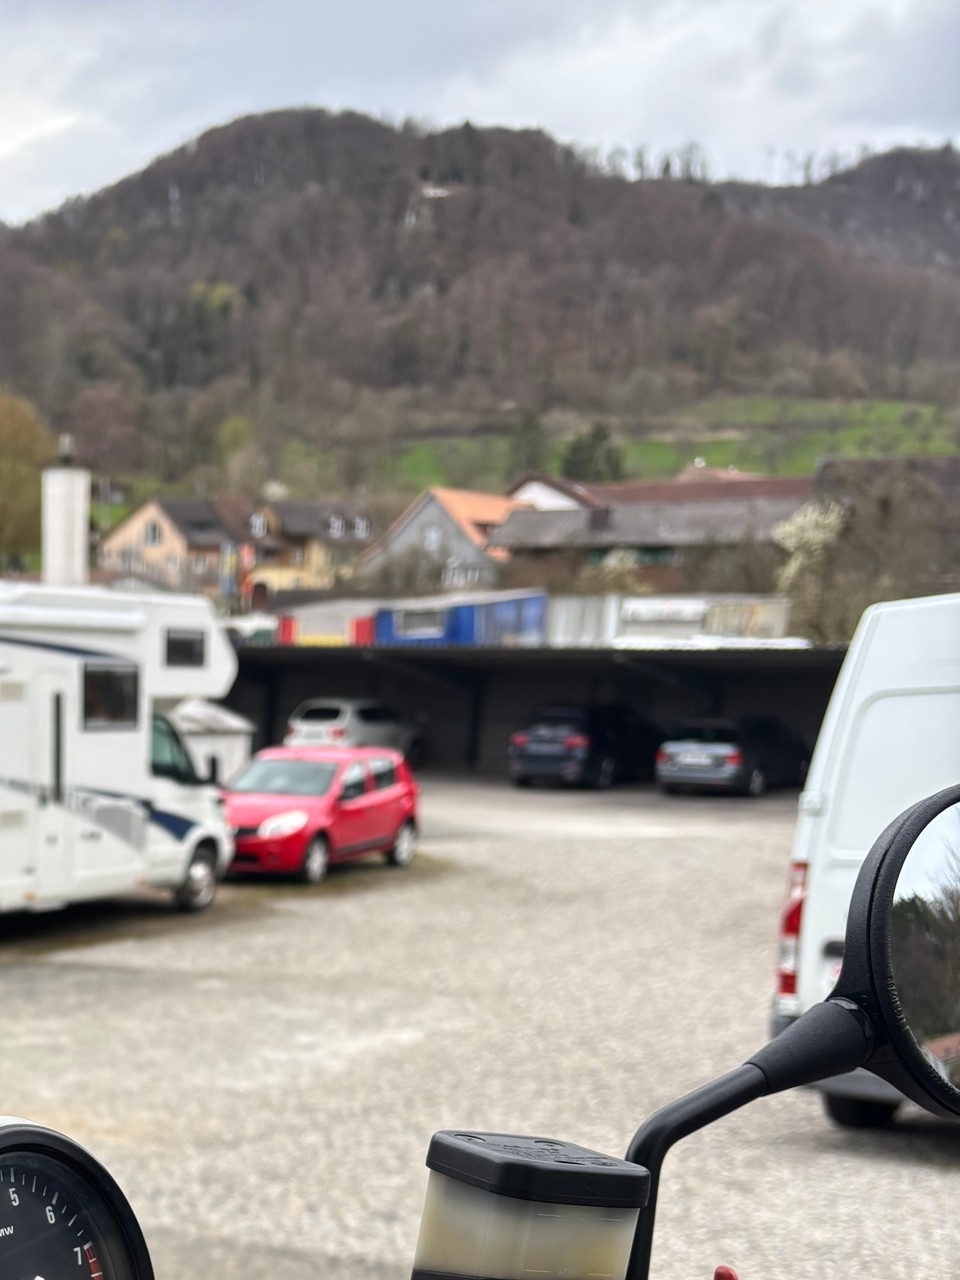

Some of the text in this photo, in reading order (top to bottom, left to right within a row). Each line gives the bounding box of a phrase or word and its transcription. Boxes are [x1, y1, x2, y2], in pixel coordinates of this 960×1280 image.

[8, 1187, 20, 1207] 5
[45, 1205, 56, 1225] 6
[73, 1246, 82, 1265] 7
